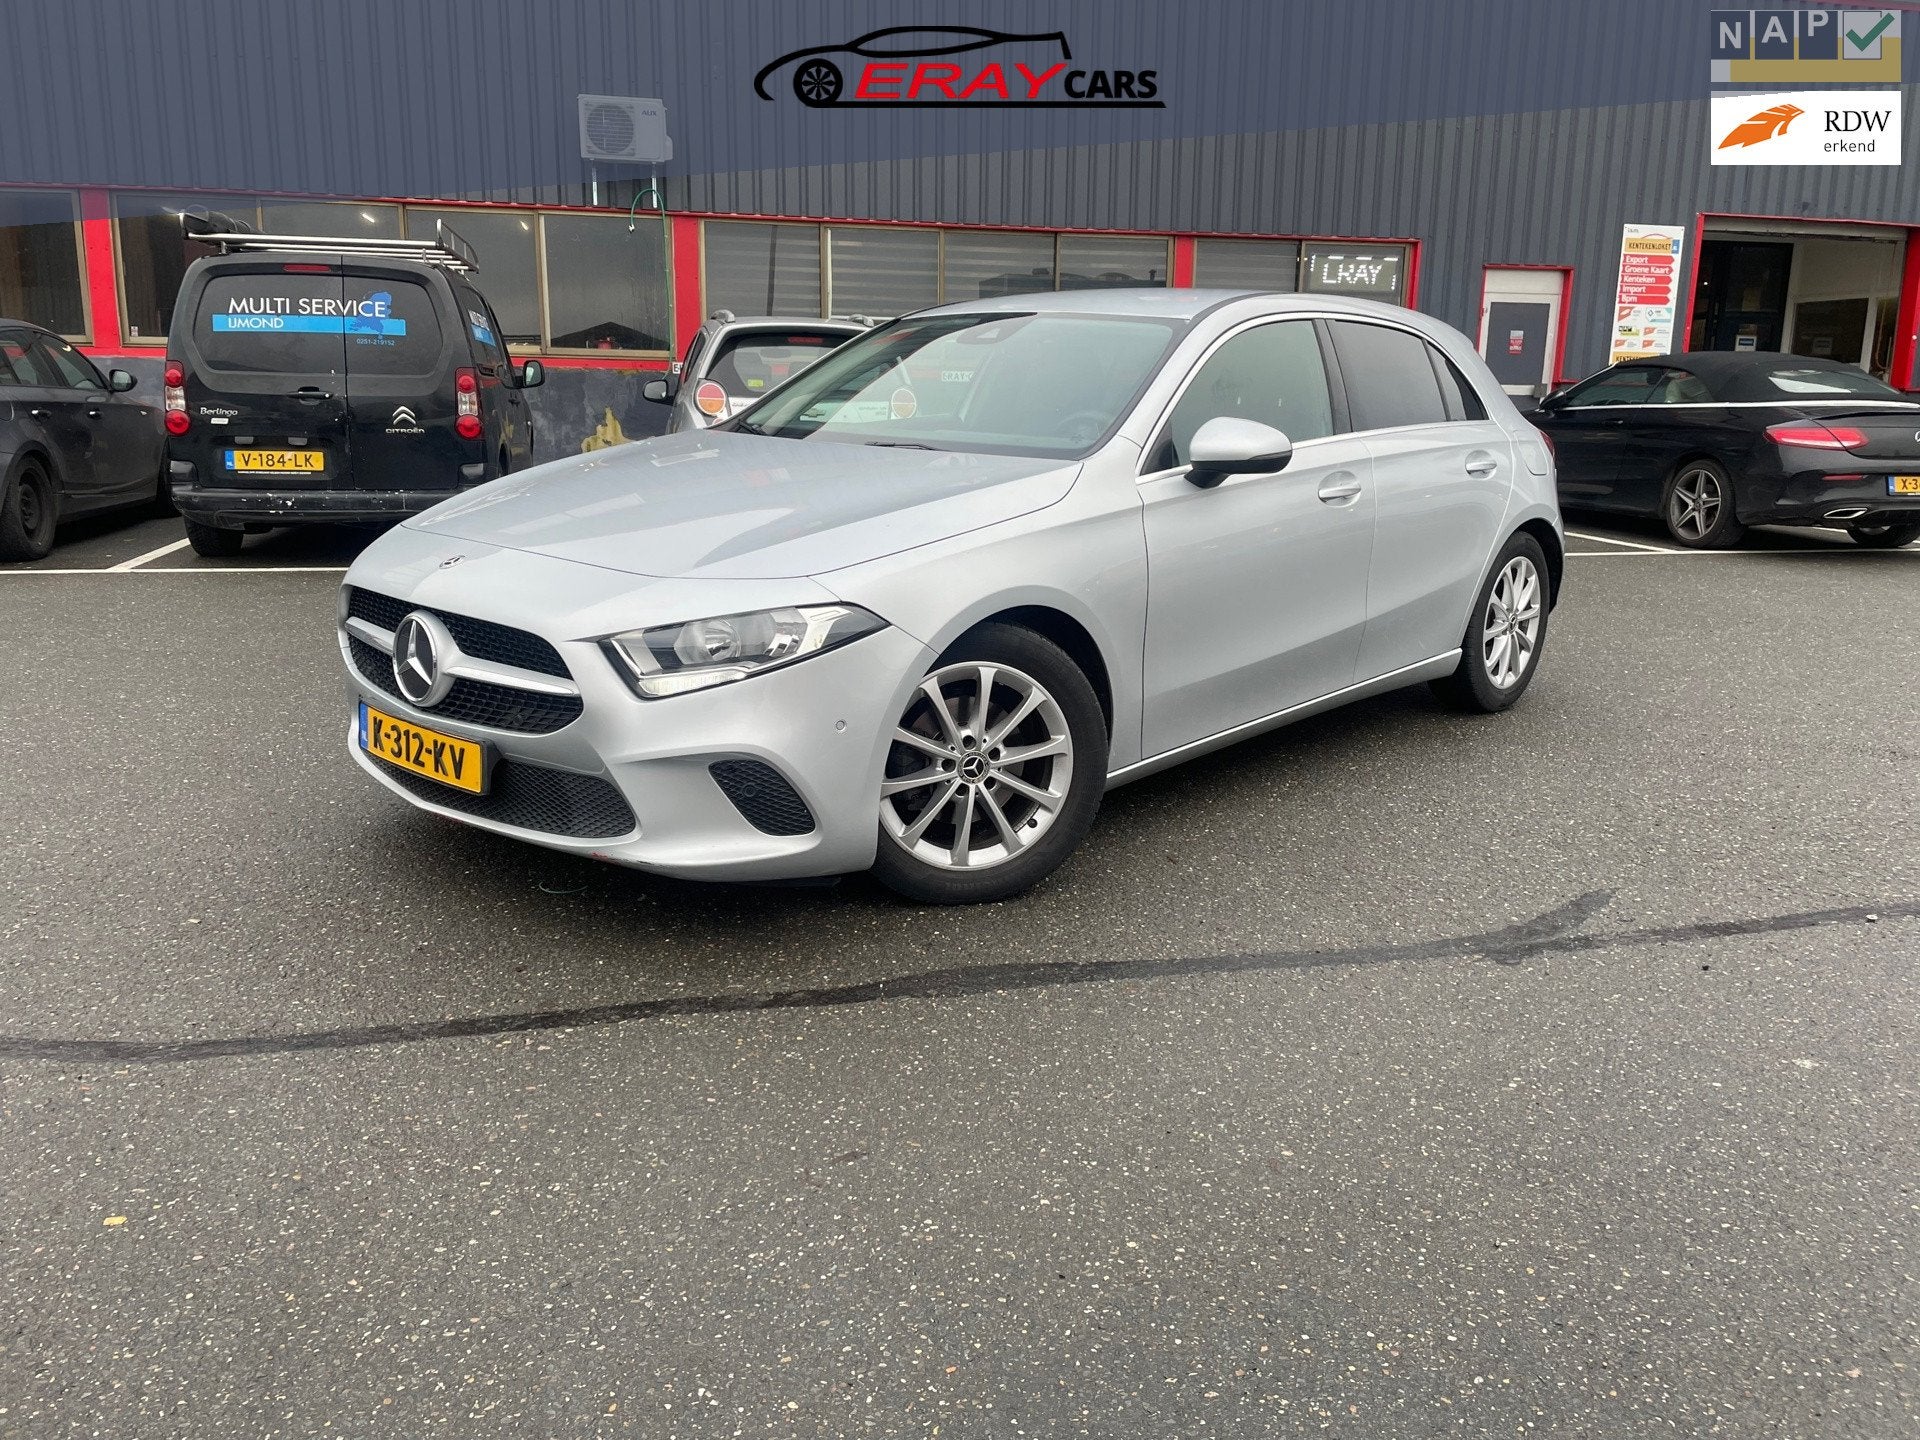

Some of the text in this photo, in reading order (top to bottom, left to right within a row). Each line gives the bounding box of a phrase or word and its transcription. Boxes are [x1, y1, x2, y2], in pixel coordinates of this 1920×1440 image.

[1628, 242, 1671, 250] KENTEKENLOKET
[1625, 255, 1648, 264] Export
[1625, 265, 1670, 274] Groene Kaart
[1623, 275, 1655, 283] Kenteken
[1622, 285, 1646, 294] Import
[228, 297, 386, 318] MULTI SERVICE
[200, 407, 238, 417] Berlingo
[241, 453, 314, 468] V-184-LK
[1901, 478, 1920, 490] X-3
[373, 716, 465, 780] K-312-KV
